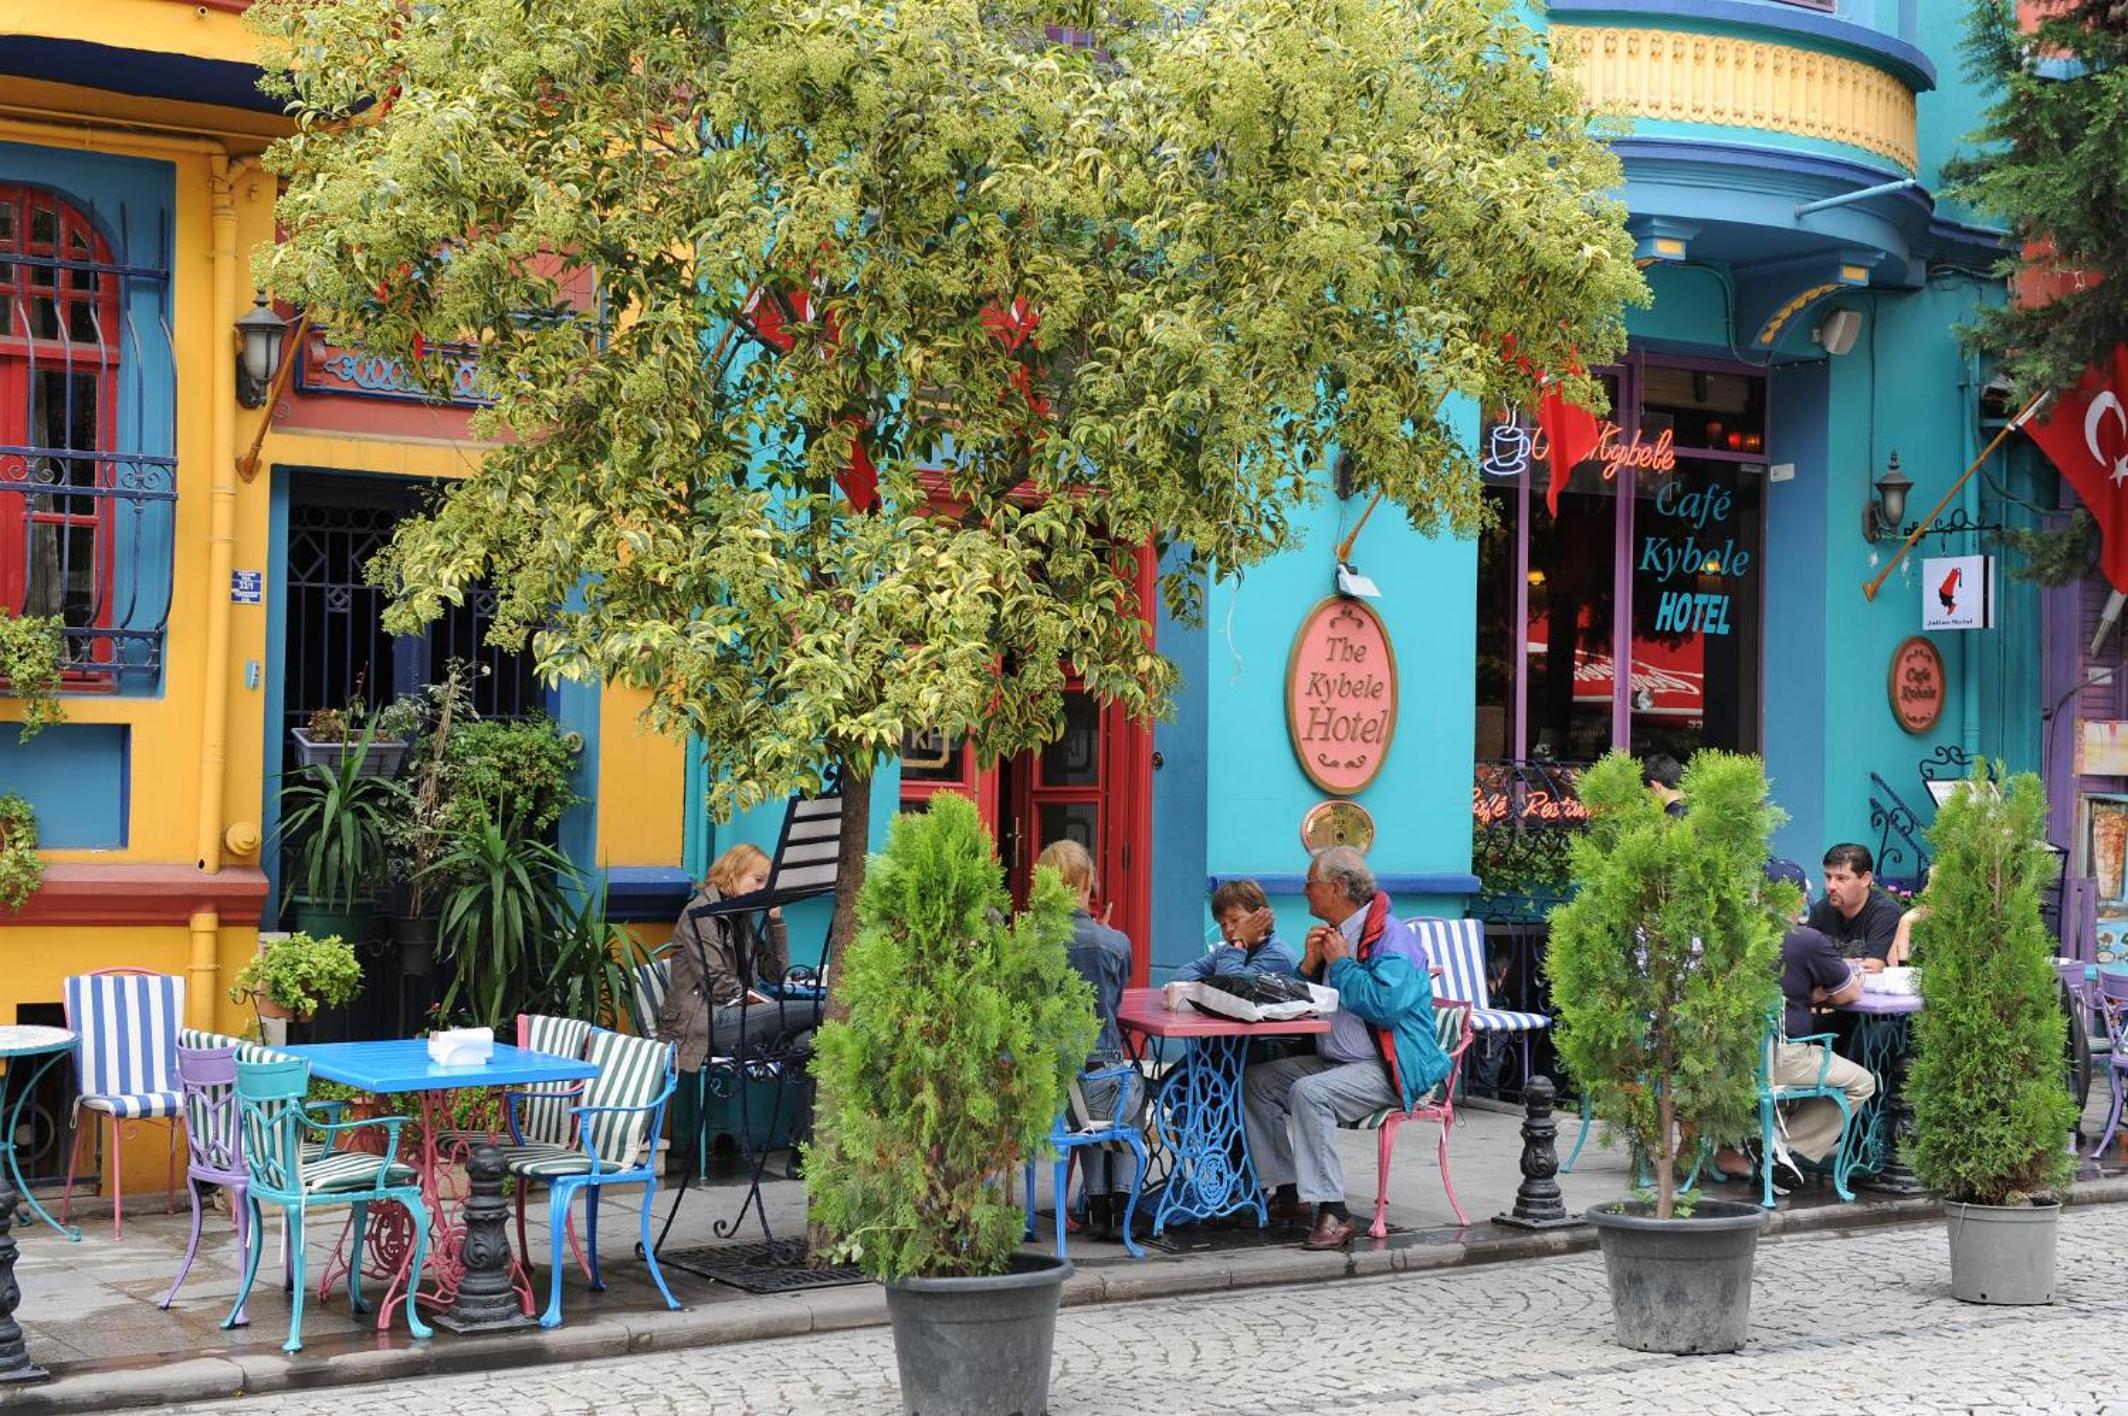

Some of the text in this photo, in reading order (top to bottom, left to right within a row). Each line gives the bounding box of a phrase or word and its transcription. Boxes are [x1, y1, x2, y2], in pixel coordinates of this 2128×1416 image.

[1590, 420, 1676, 480] Kybele
[1656, 482, 1731, 529] Café
[1638, 537, 1749, 582] Kybele
[1655, 591, 1730, 634] HOTEL
[1326, 636, 1367, 663] The
[1305, 672, 1384, 704] Kybele
[1302, 707, 1388, 745] Hotel
